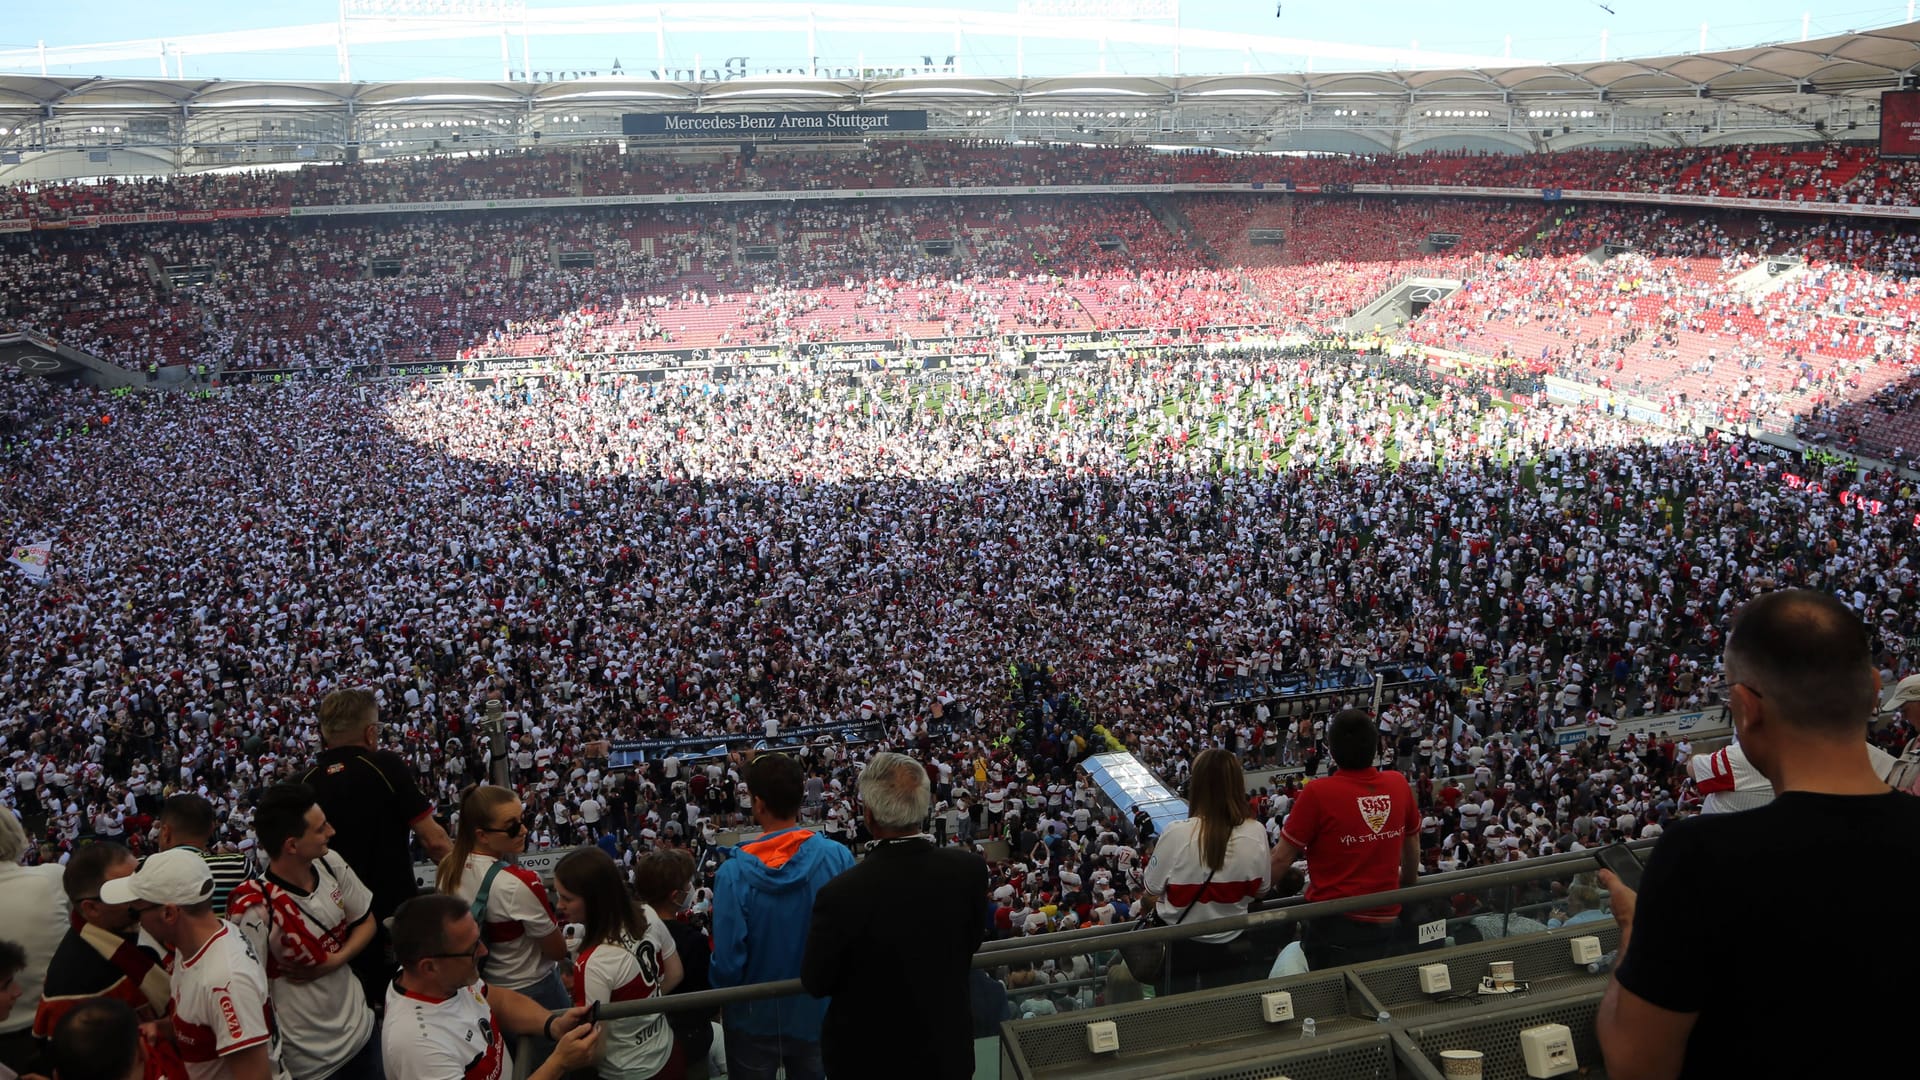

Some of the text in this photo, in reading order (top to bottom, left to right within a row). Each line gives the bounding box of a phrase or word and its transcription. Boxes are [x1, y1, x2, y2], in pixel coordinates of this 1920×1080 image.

[664, 113, 889, 130] Mercedes-Benz Arena Stuttgart
[99, 214, 137, 224] GIENGEN
